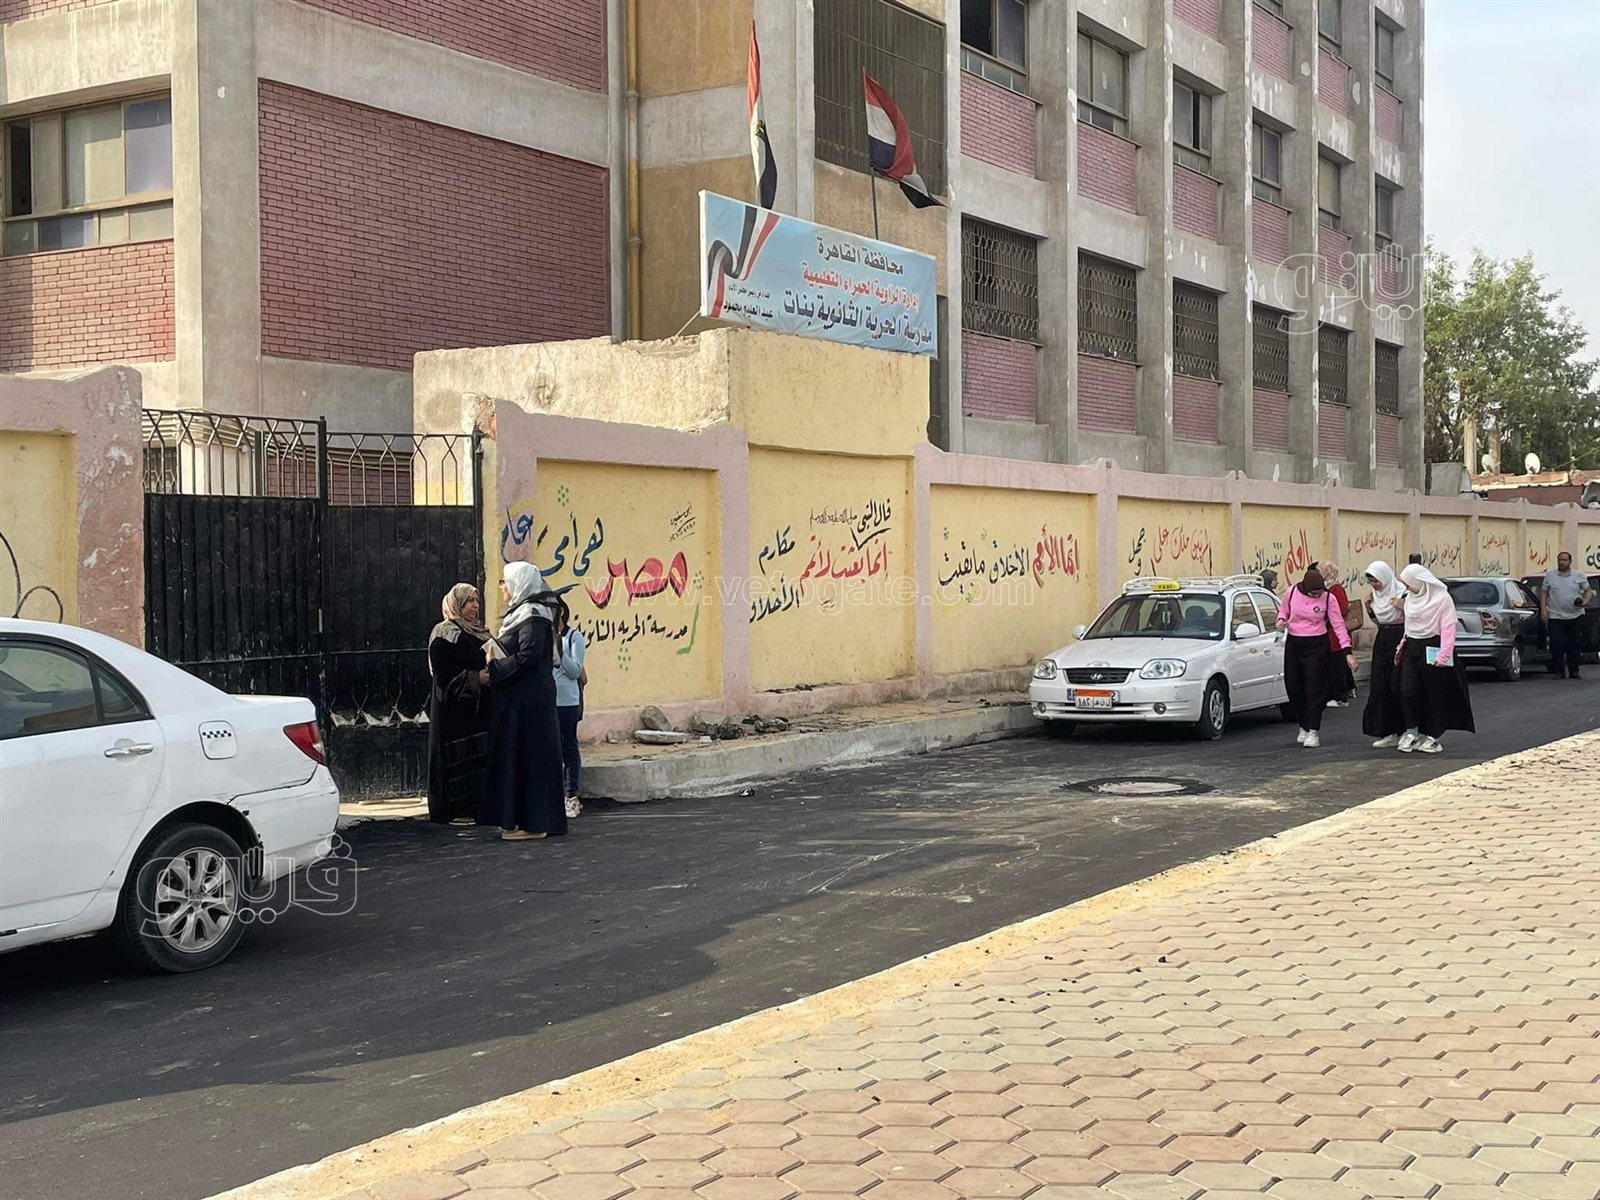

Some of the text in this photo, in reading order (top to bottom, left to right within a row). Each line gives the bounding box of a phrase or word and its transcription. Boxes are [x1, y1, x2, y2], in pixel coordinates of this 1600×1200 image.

[817, 236, 904, 275] محافظة القاهرة
[802, 261, 920, 313] إدارة الزاوية الحمراء التعليمية
[783, 289, 815, 327] بنات
[817, 294, 863, 331] الثانوية
[866, 305, 901, 340] الحرية
[903, 314, 932, 346] مدرسة
[758, 526, 796, 575] مكارم
[585, 551, 688, 610] مصر
[646, 614, 688, 640] مدرسة
